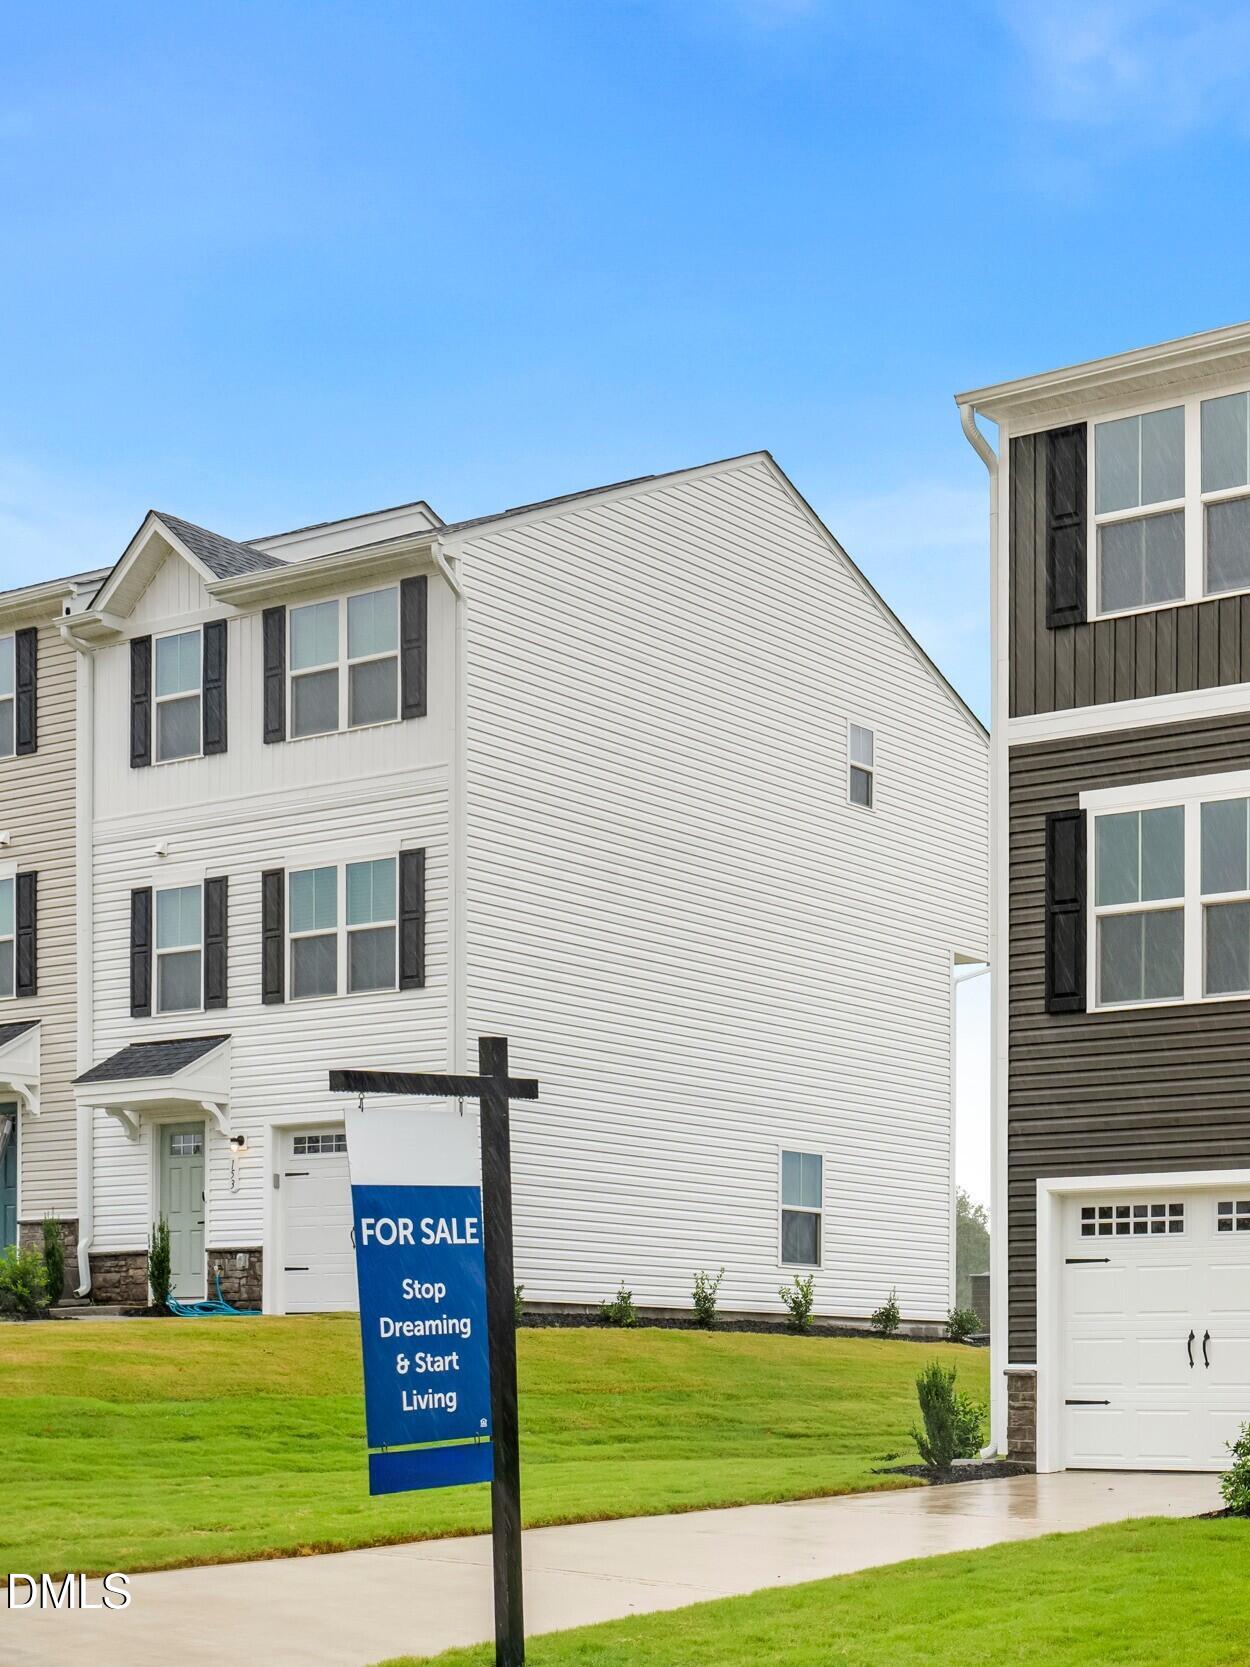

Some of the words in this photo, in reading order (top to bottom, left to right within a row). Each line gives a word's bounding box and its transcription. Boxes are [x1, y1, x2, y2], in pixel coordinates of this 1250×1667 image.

[361, 1217, 415, 1246] FOR
[420, 1217, 480, 1245] SALE
[402, 1278, 446, 1303] Stop
[379, 1314, 471, 1339] Dreaming
[396, 1353, 410, 1375] &
[415, 1351, 460, 1374] Start
[401, 1388, 457, 1413] Living
